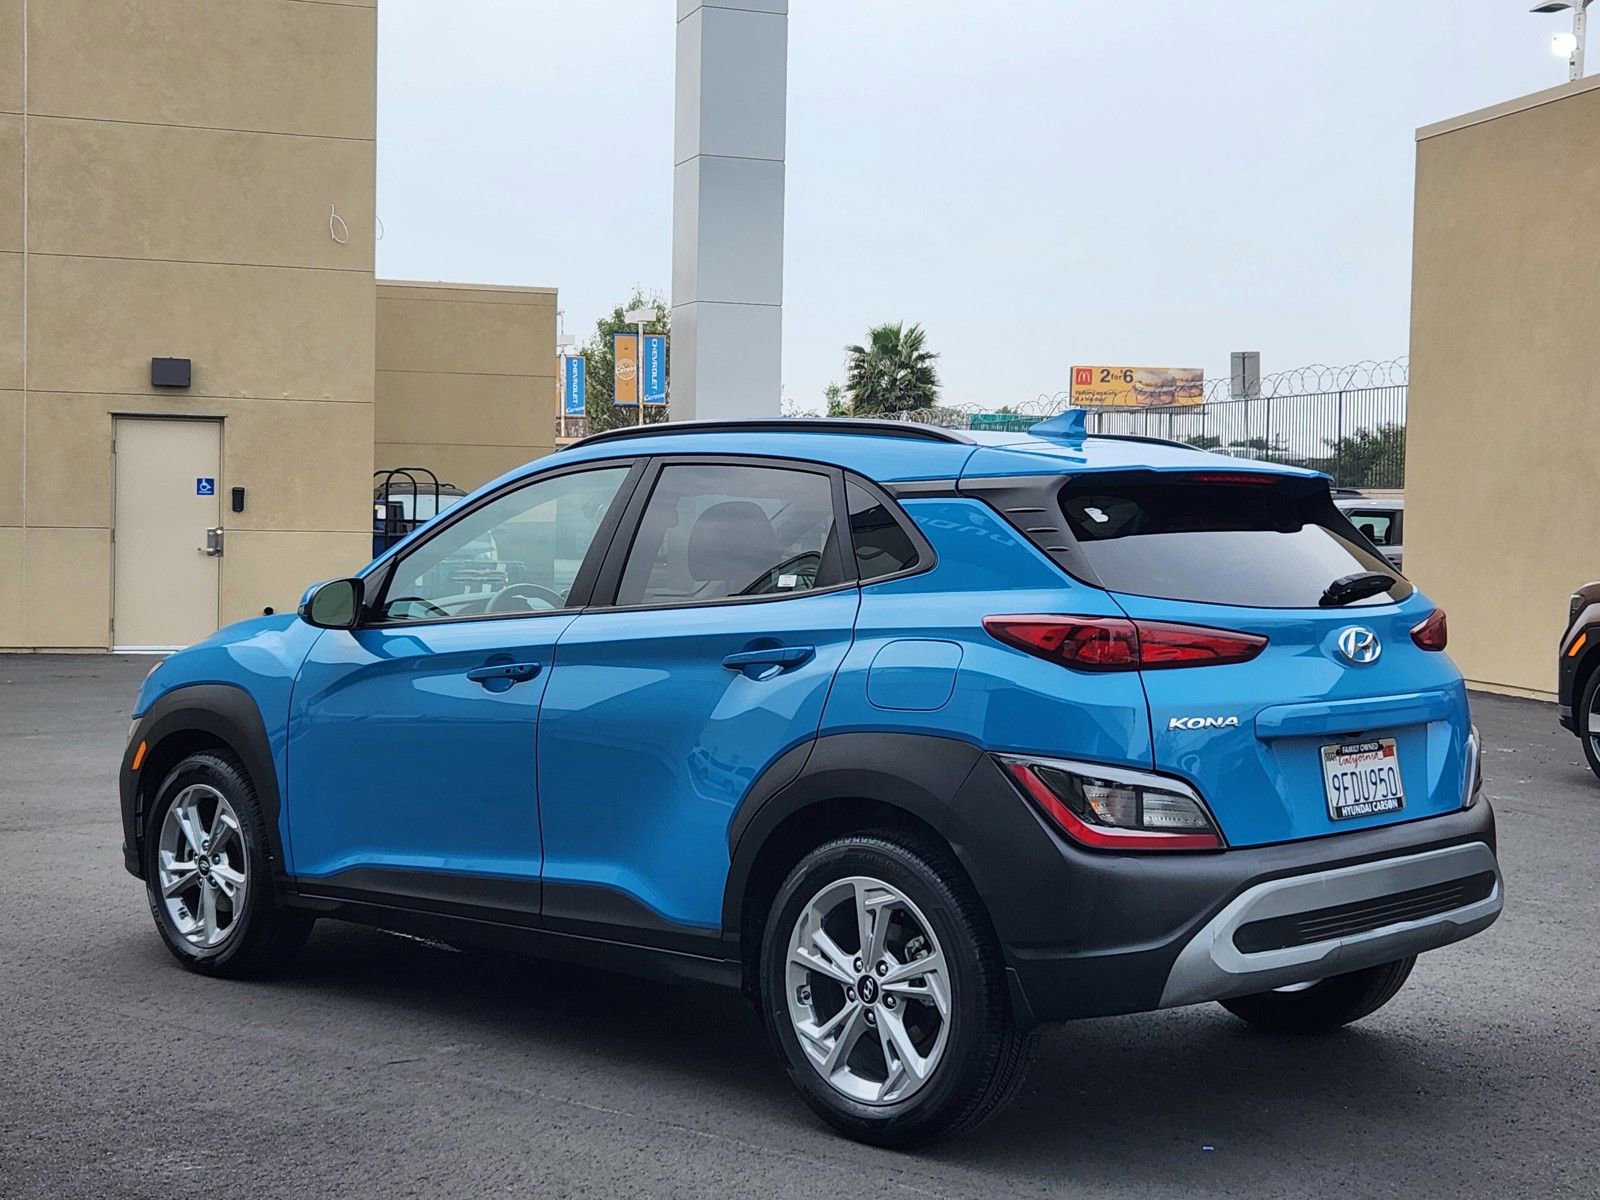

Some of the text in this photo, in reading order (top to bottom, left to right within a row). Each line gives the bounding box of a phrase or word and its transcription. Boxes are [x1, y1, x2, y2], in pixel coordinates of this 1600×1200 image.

[1100, 368, 1111, 383] 2
[1168, 716, 1240, 731] KONA
[1341, 744, 1360, 754] FAMILY
[1359, 742, 1379, 752] OWNED
[1338, 752, 1378, 768] California
[1332, 766, 1398, 806] 9FDU950
[1341, 799, 1399, 817] HYUNDAI CARSON
